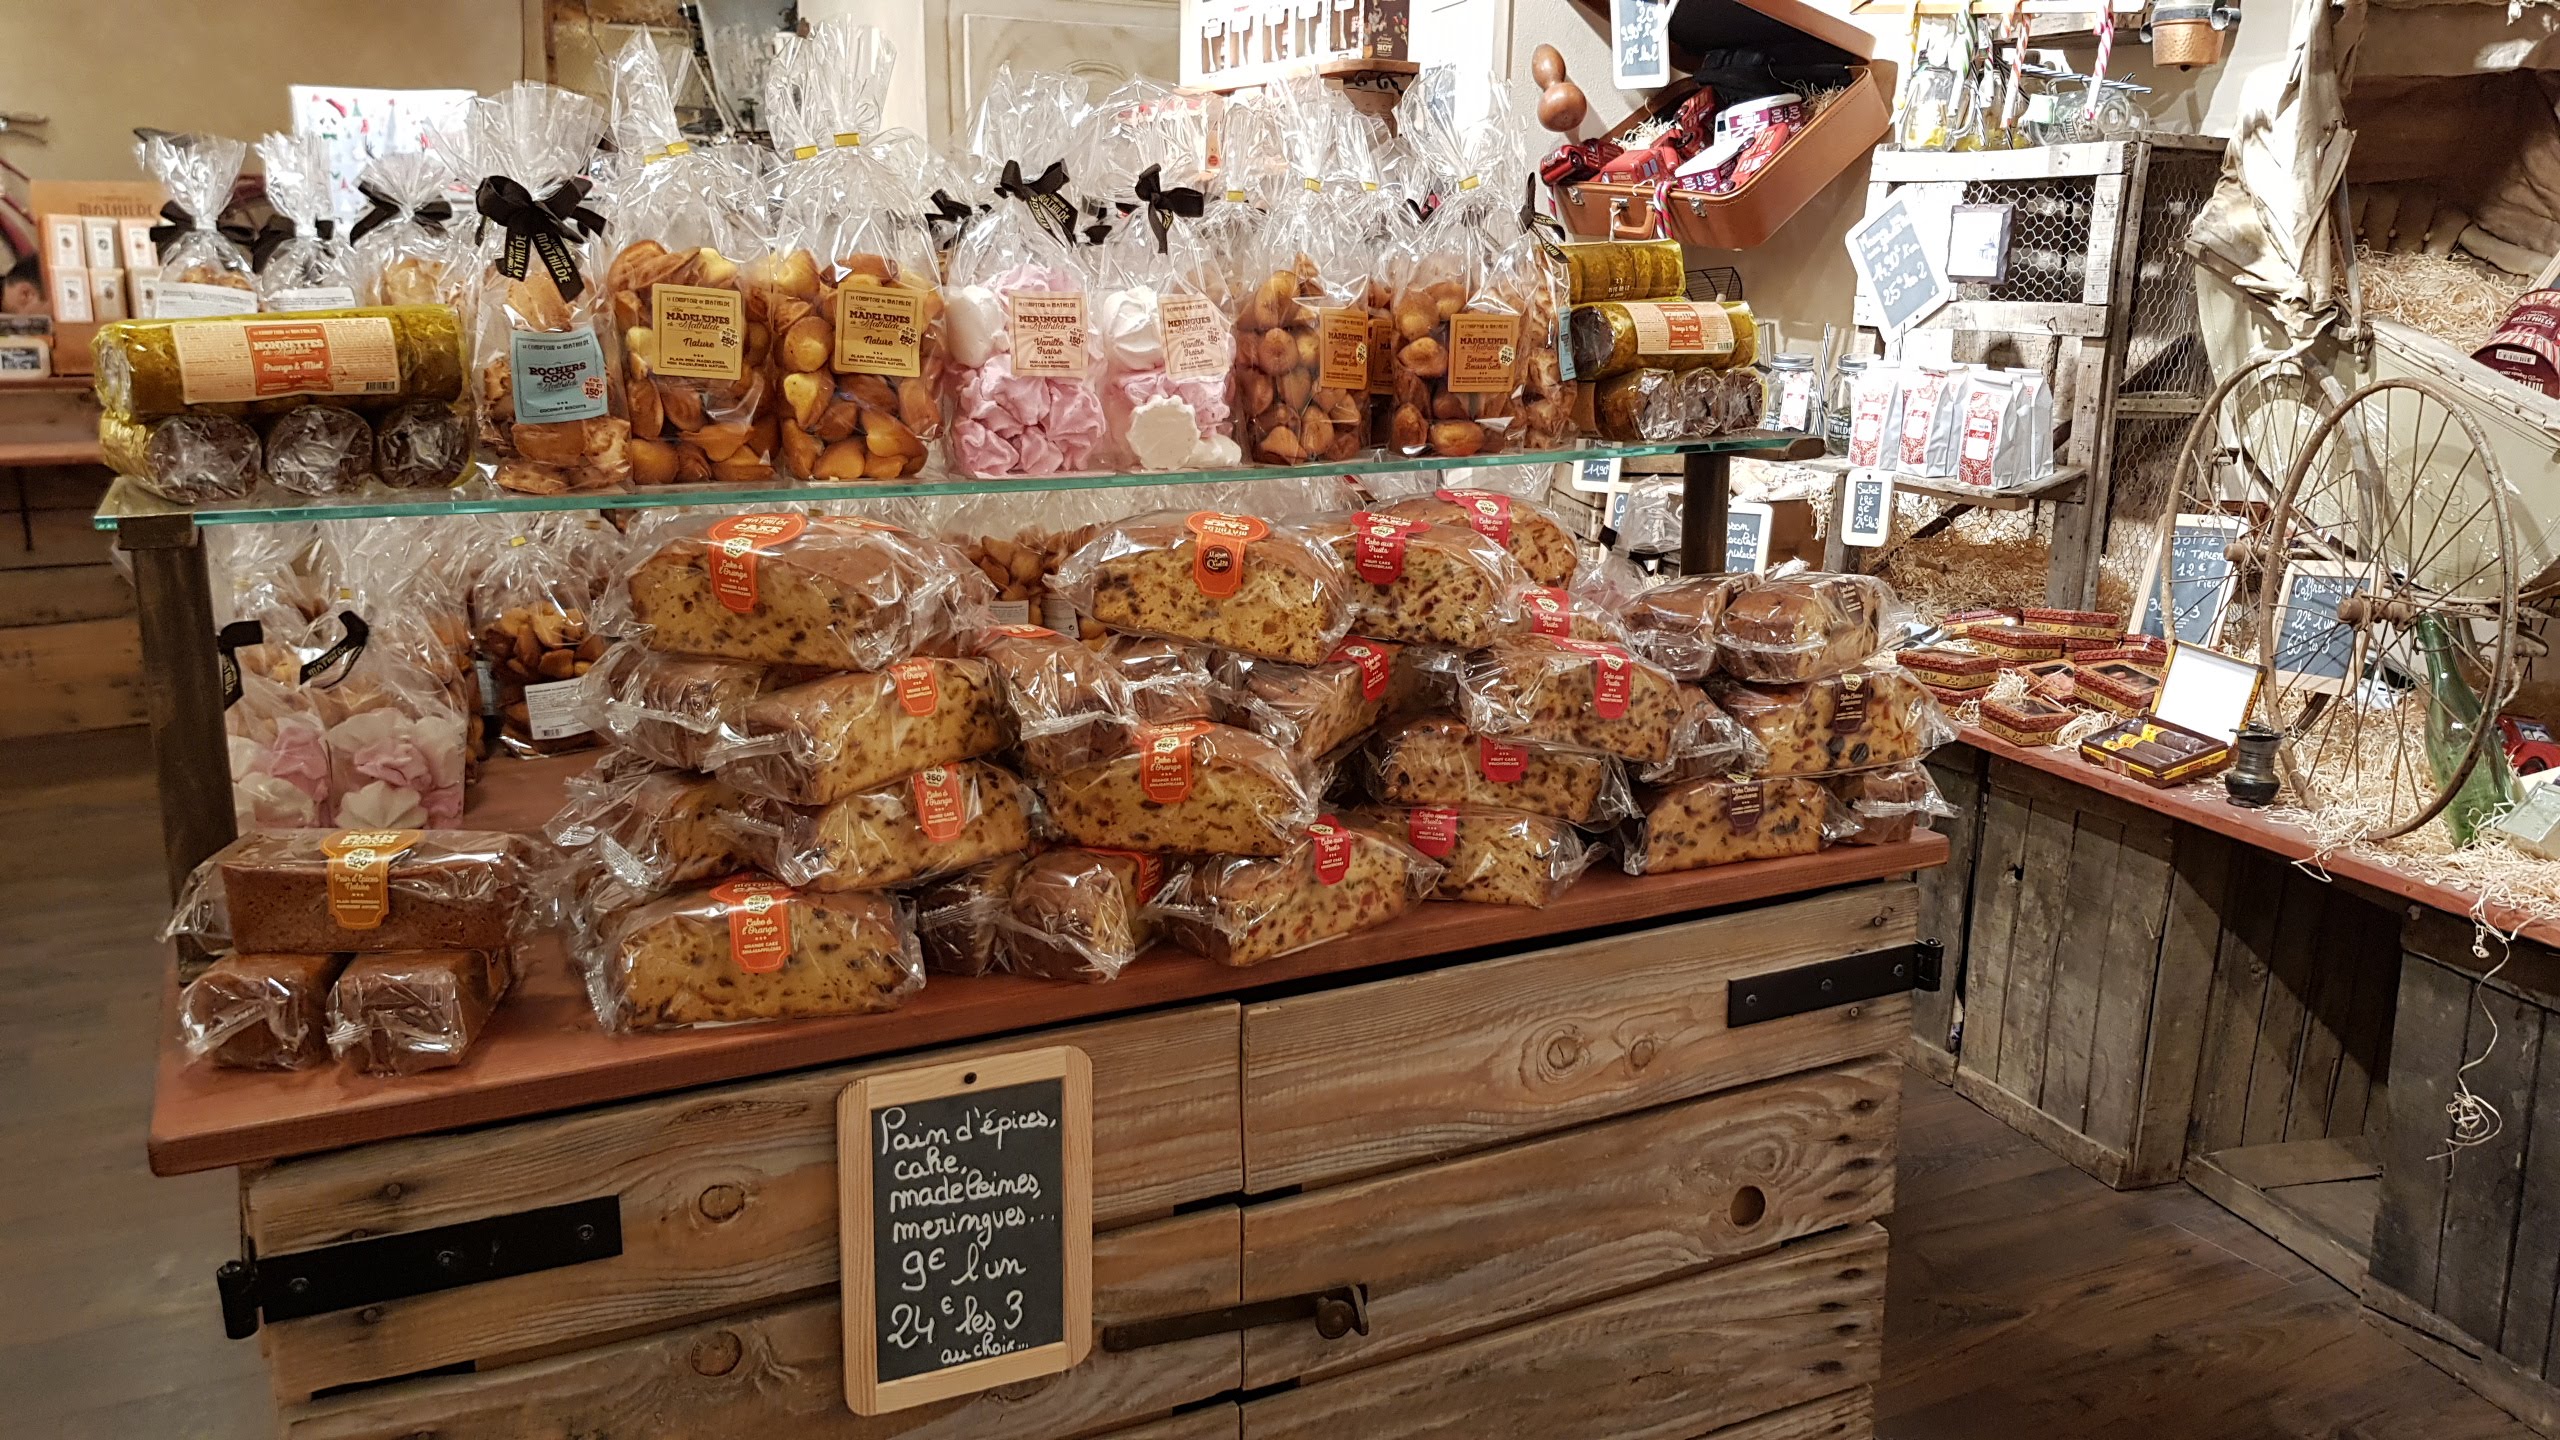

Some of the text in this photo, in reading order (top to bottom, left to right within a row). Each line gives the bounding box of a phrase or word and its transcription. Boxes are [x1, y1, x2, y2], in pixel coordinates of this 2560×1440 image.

[513, 235, 526, 277] ATHILDE
[536, 233, 570, 283] MATHILDE
[705, 299, 730, 307] MATHILDE
[666, 312, 730, 324] MADELEINES
[849, 310, 910, 324] MADELEINES
[1019, 315, 1076, 323] MERINGUES
[1168, 316, 1211, 327] MERINGUES
[2511, 314, 2556, 327] MATHILDE
[254, 339, 324, 351] NONNETTES
[683, 337, 714, 347] Nature
[864, 335, 893, 346] Nature
[1034, 338, 1064, 346] Vanille
[1037, 347, 1062, 355] Fraise
[263, 361, 294, 373] Orange
[303, 361, 324, 370] Miel
[529, 362, 586, 375] ROCHERS
[543, 372, 575, 383] COCO
[1857, 483, 1880, 494] Sachet
[734, 524, 783, 533] CAKE
[1204, 519, 1250, 531] CAKE
[1365, 538, 1380, 546] Cake
[1369, 545, 1389, 553] Fruits
[927, 790, 942, 798] Cake
[925, 798, 953, 807] l'Orange
[746, 918, 765, 926] Cake
[742, 925, 778, 935] l'Orange
[881, 1106, 1056, 1155] Pain d'épices,
[894, 1146, 968, 1181] cake,
[890, 1168, 1042, 1214] madeleines,
[955, 1295, 996, 1335] les
[1003, 1289, 1024, 1330] 3
[940, 1349, 971, 1365] au
